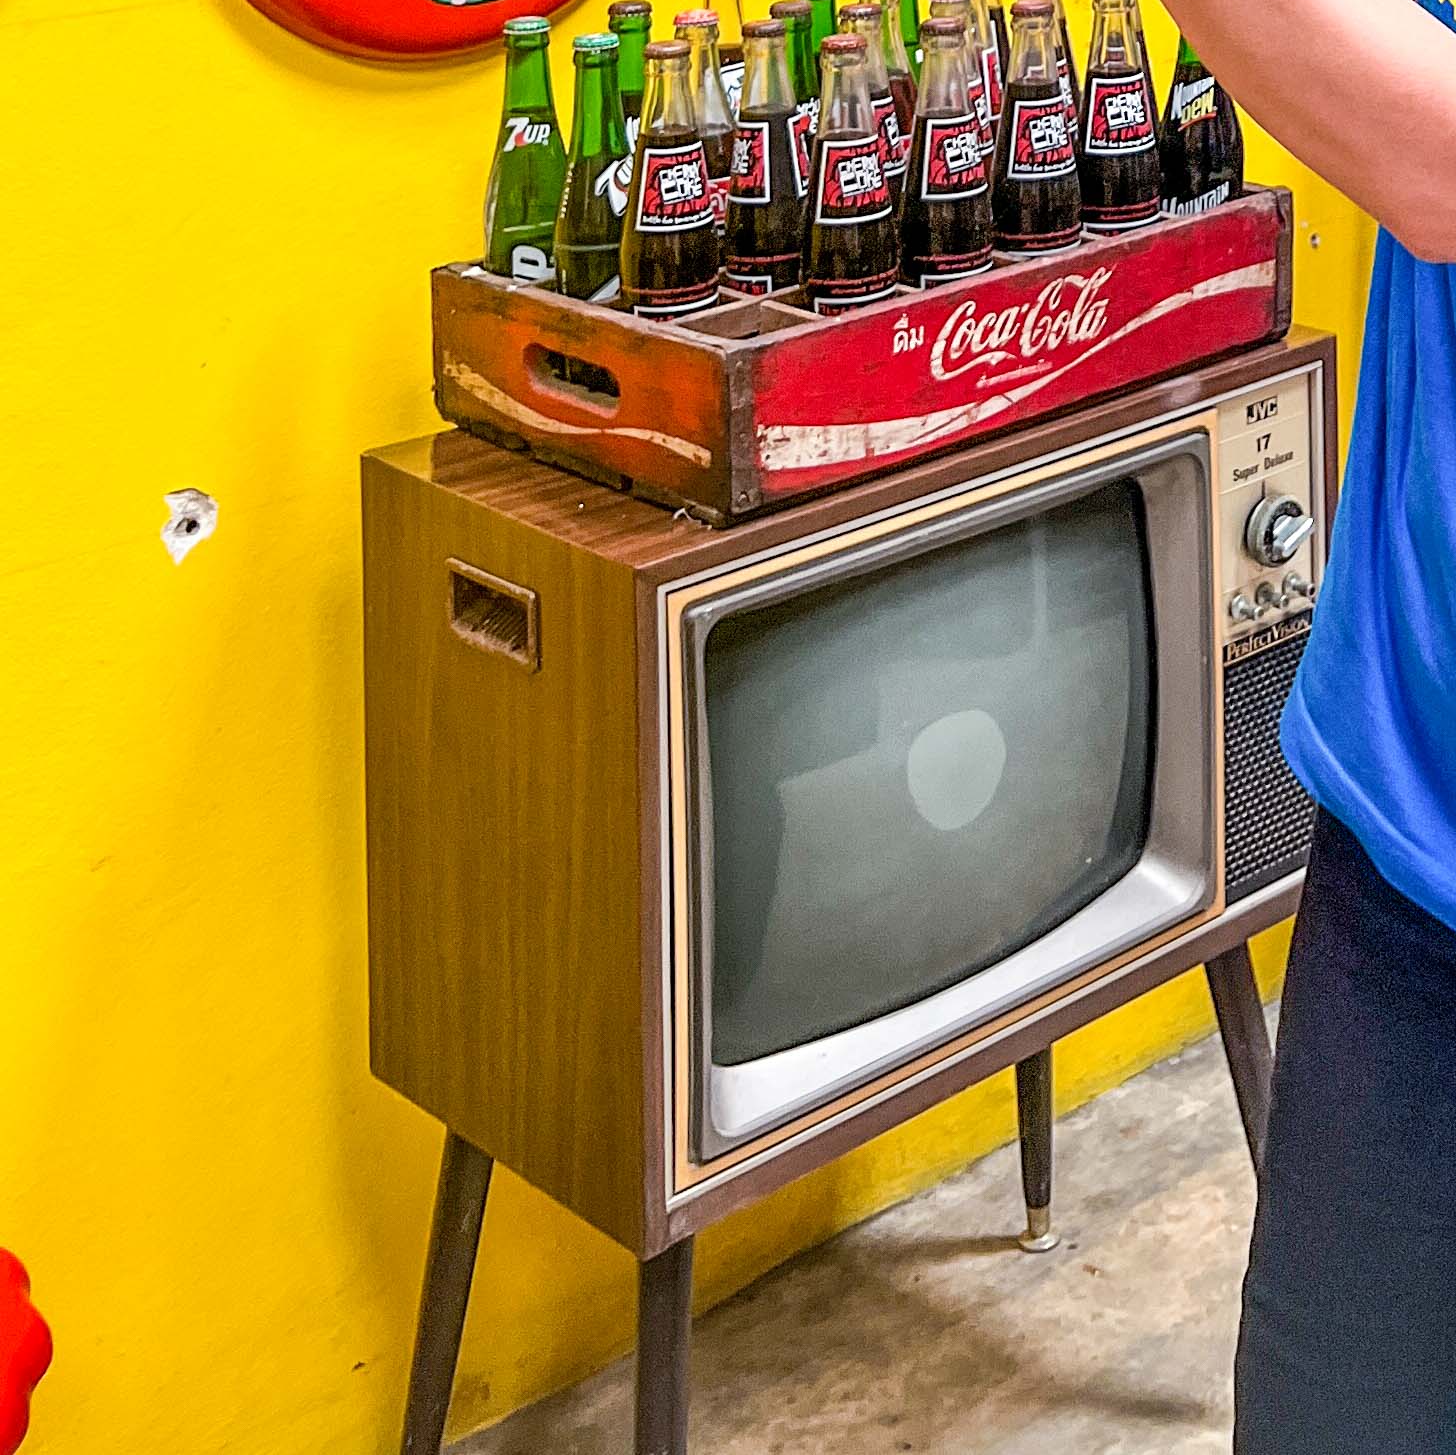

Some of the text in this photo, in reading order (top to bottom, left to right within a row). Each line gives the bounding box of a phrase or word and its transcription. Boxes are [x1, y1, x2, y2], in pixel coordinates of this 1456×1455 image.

[504, 117, 549, 152] 7UP
[892, 263, 1117, 382] ดื่ม Coca-Cola
[1247, 396, 1278, 424] JVC
[1256, 433, 1271, 453] 17
[1233, 451, 1294, 482] Super Deluxe
